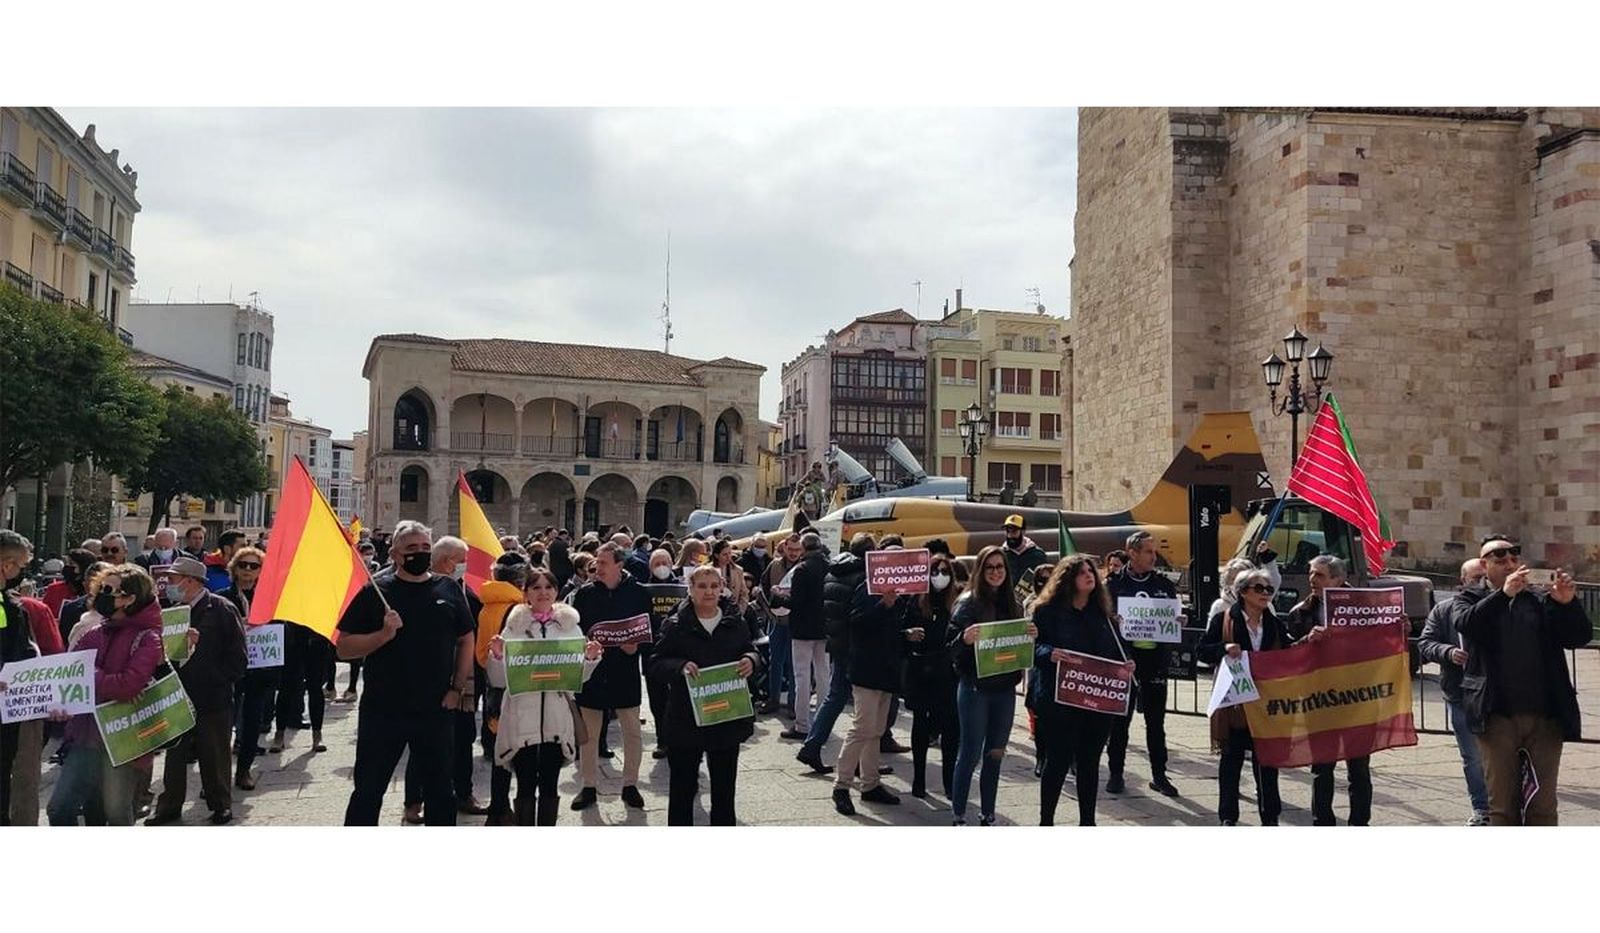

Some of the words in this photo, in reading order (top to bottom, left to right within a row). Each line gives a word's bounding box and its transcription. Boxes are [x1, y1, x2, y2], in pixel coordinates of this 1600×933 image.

[874, 565, 927, 576] ¡DEVOLVED
[872, 577, 885, 585] LO
[1127, 605, 1175, 618] SOBERANÍA
[1334, 605, 1401, 616] ¡DEVOLVED
[1158, 620, 1179, 638] YA!
[1331, 618, 1347, 626] LO
[979, 638, 995, 650] NOS
[261, 646, 281, 661] YA!
[508, 654, 530, 667] NOS
[531, 652, 585, 665] ARRUINAN
[10, 659, 85, 685] SOBERANÍA
[1065, 669, 1127, 689] ¡DEVOLVED
[699, 677, 747, 697] ARRUINAN
[1061, 680, 1076, 690] LO
[58, 683, 90, 705] YA!
[104, 716, 130, 735] NOS
[131, 689, 184, 726] ARRUINAN
